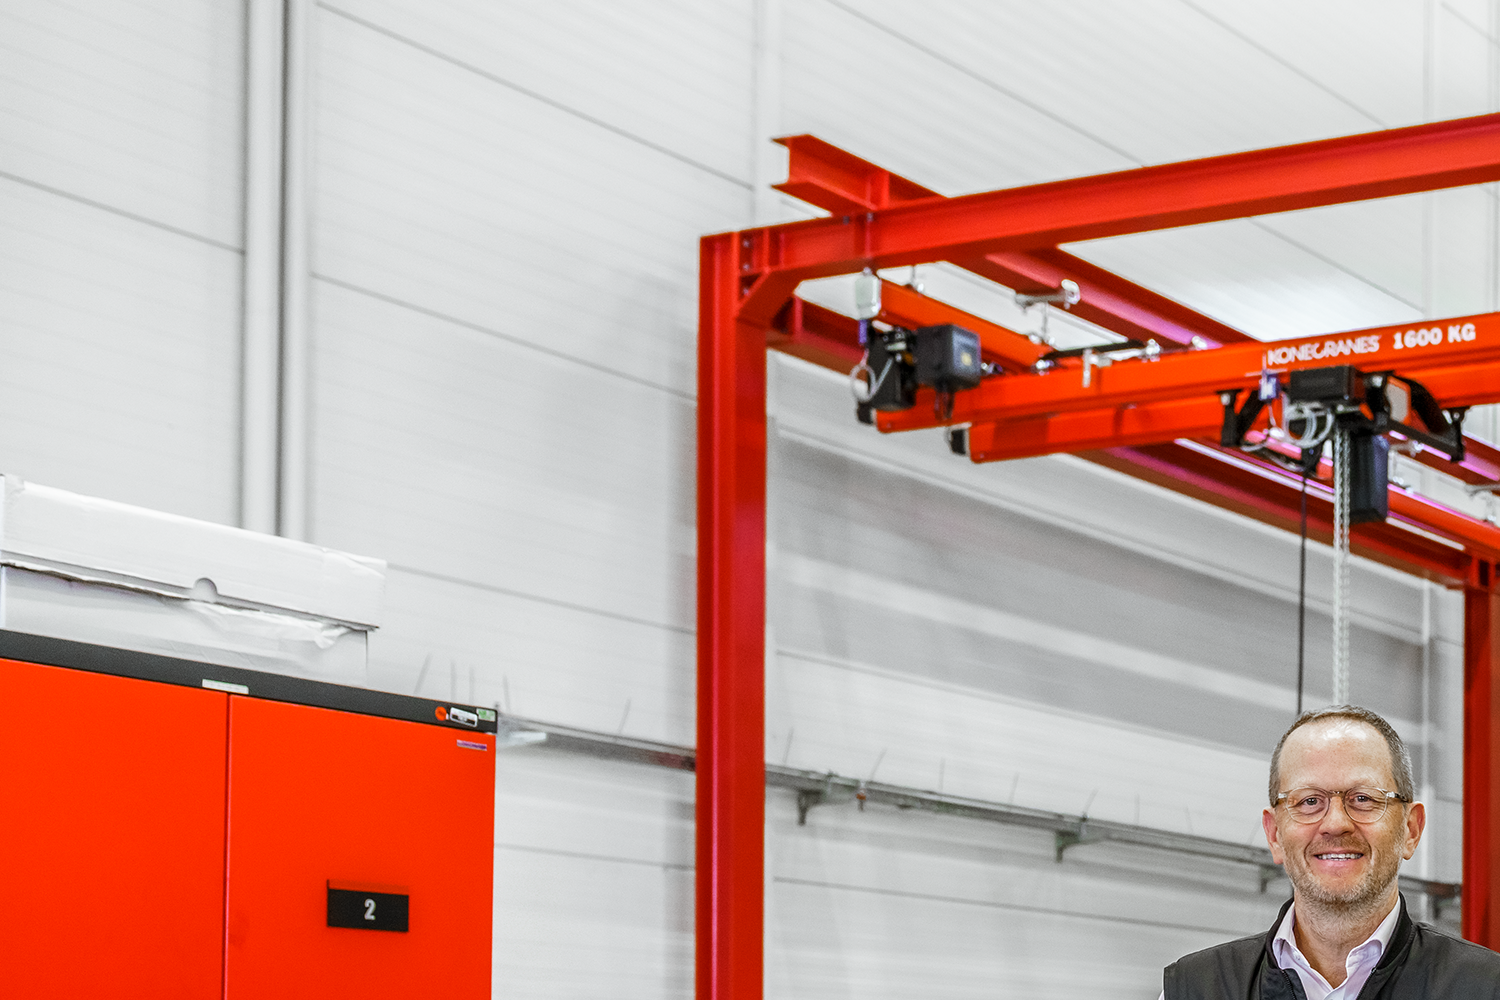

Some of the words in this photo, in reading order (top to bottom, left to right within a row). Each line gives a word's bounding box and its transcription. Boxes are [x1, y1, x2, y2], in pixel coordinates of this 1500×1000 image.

[1267, 334, 1381, 366] KONECRANES
[1393, 327, 1443, 350] 1600
[1447, 323, 1476, 343] KG
[364, 898, 376, 920] 2
